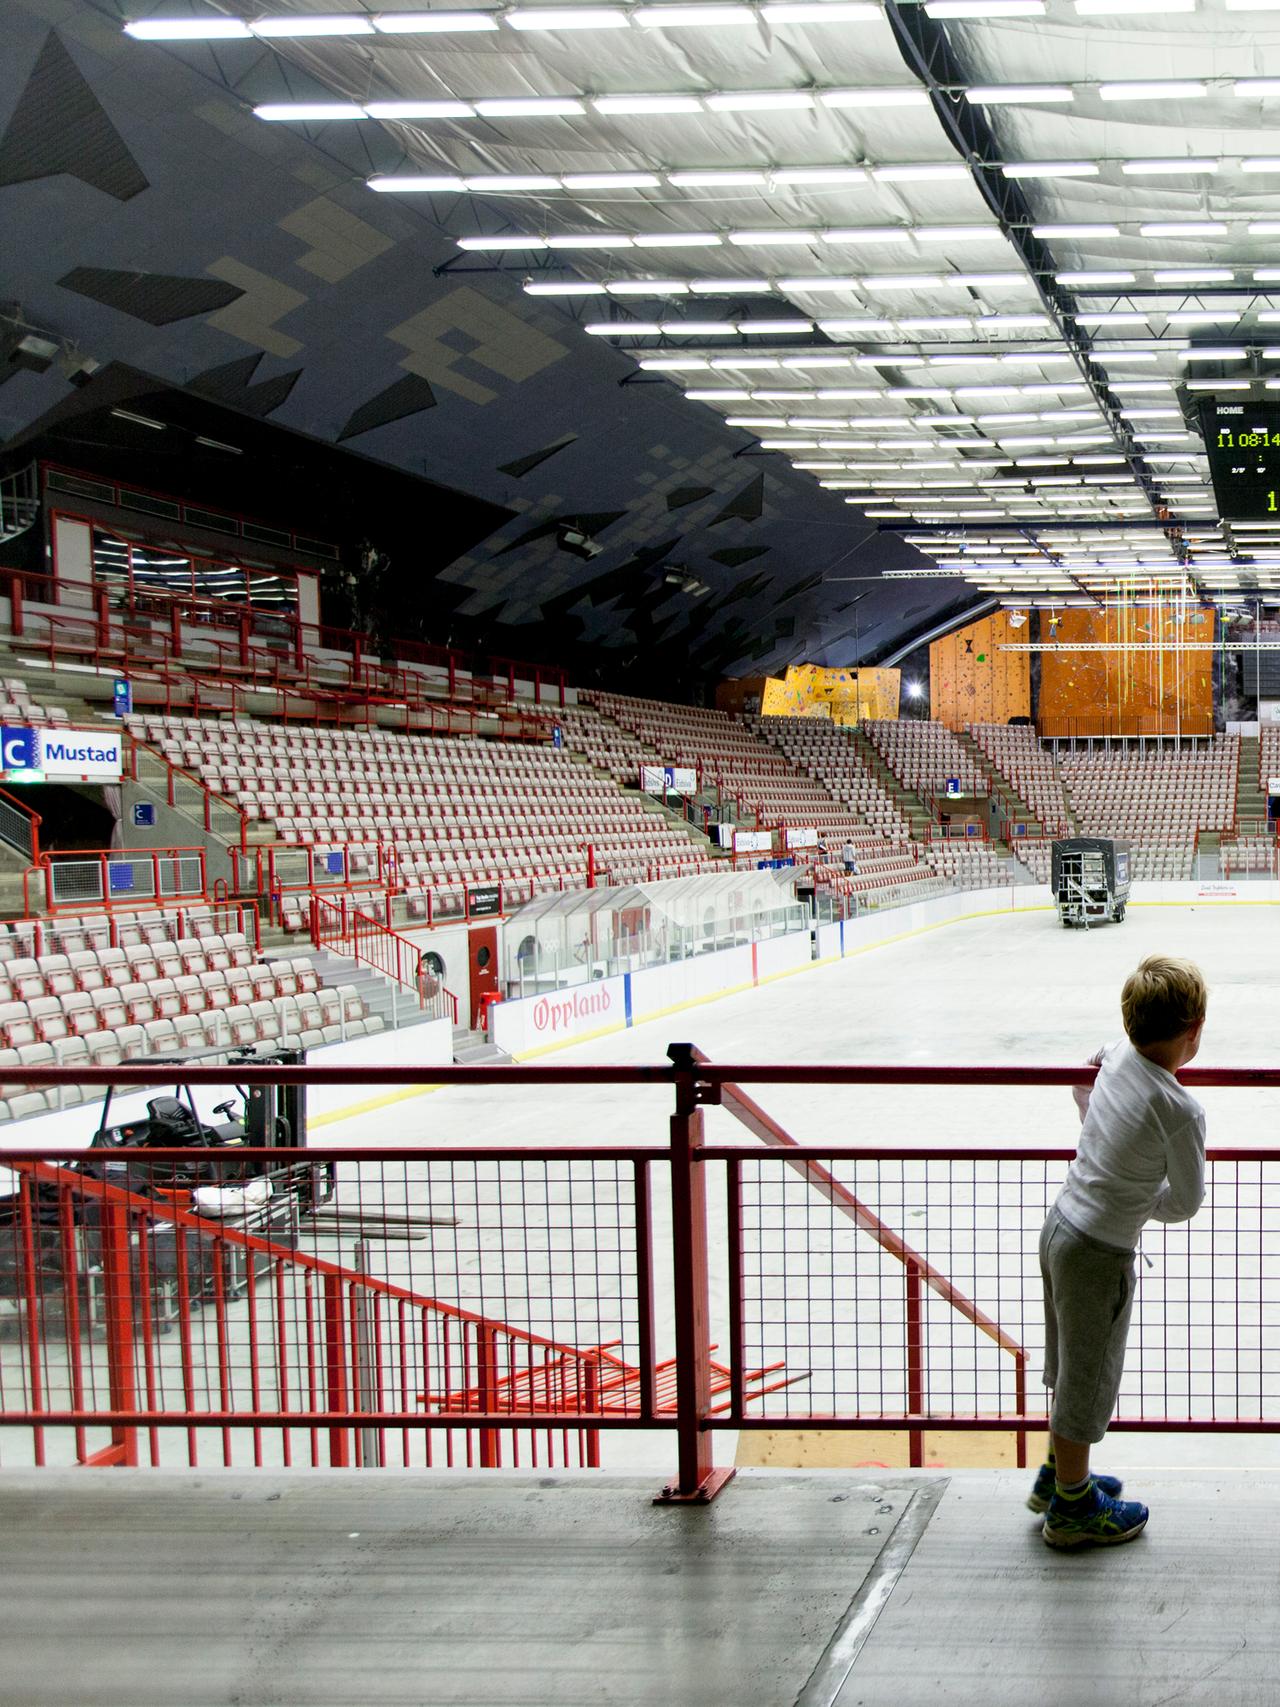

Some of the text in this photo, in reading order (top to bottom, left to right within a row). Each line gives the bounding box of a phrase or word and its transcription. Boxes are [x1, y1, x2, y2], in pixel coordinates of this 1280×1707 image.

[1216, 406, 1244, 415] HOME
[1217, 434, 1234, 447] 11
[4, 739, 117, 767] C Mustad
[665, 773, 672, 787] D
[948, 783, 955, 792] E
[533, 984, 611, 1032] Oppland
